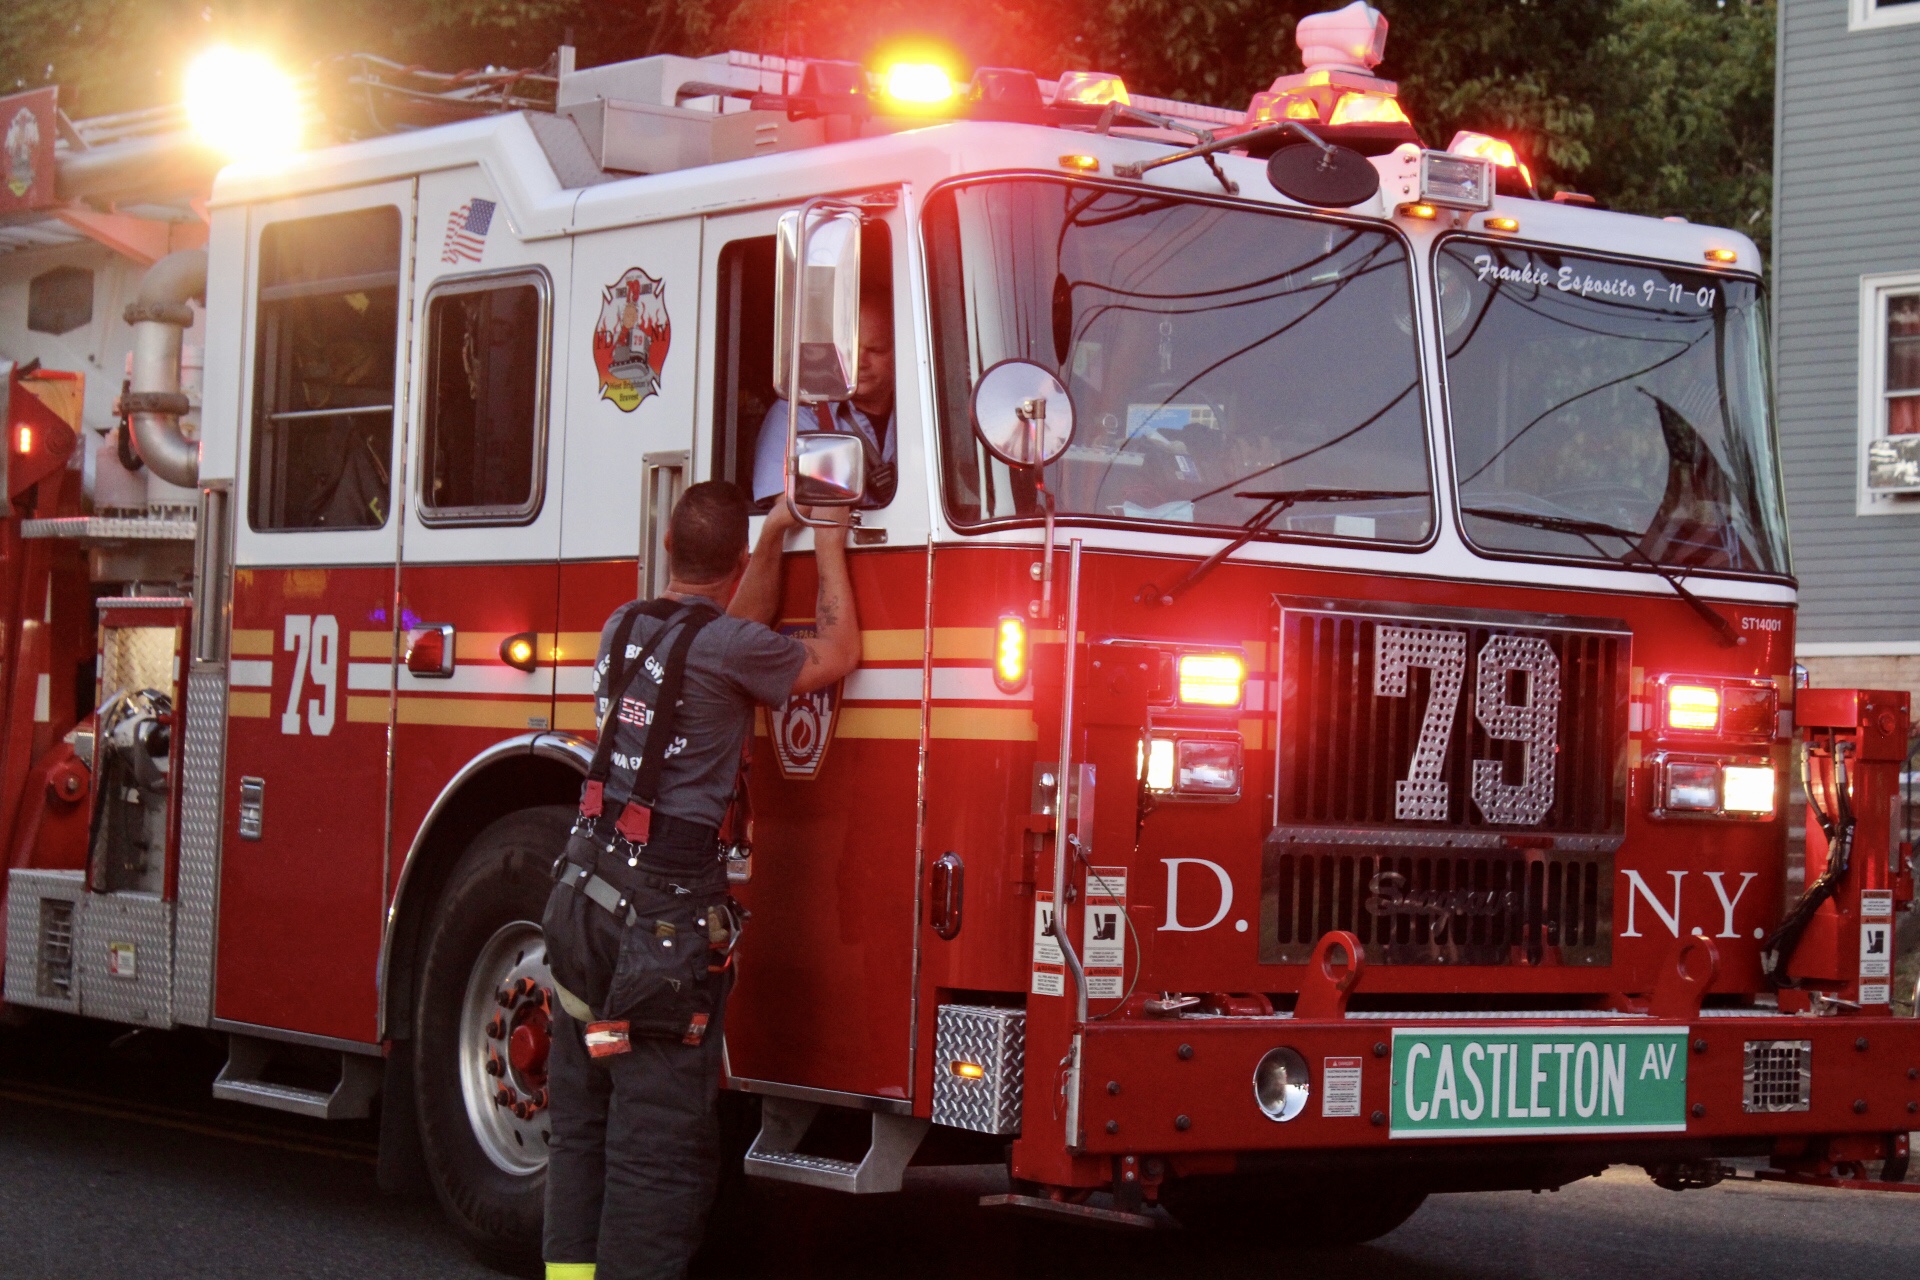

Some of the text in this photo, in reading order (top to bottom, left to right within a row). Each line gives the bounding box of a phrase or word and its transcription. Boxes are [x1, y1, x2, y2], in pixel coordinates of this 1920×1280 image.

[1474, 254, 1716, 309] Frankie Esposito 9-11-01
[1741, 617, 1781, 631] ST14001
[282, 614, 339, 736] 79
[1374, 625, 1560, 825] 79
[1157, 858, 1248, 932] D.
[1620, 869, 1764, 940] N.Y.
[1405, 1041, 1626, 1121] CASTLETON
[1639, 1043, 1677, 1080] AV
